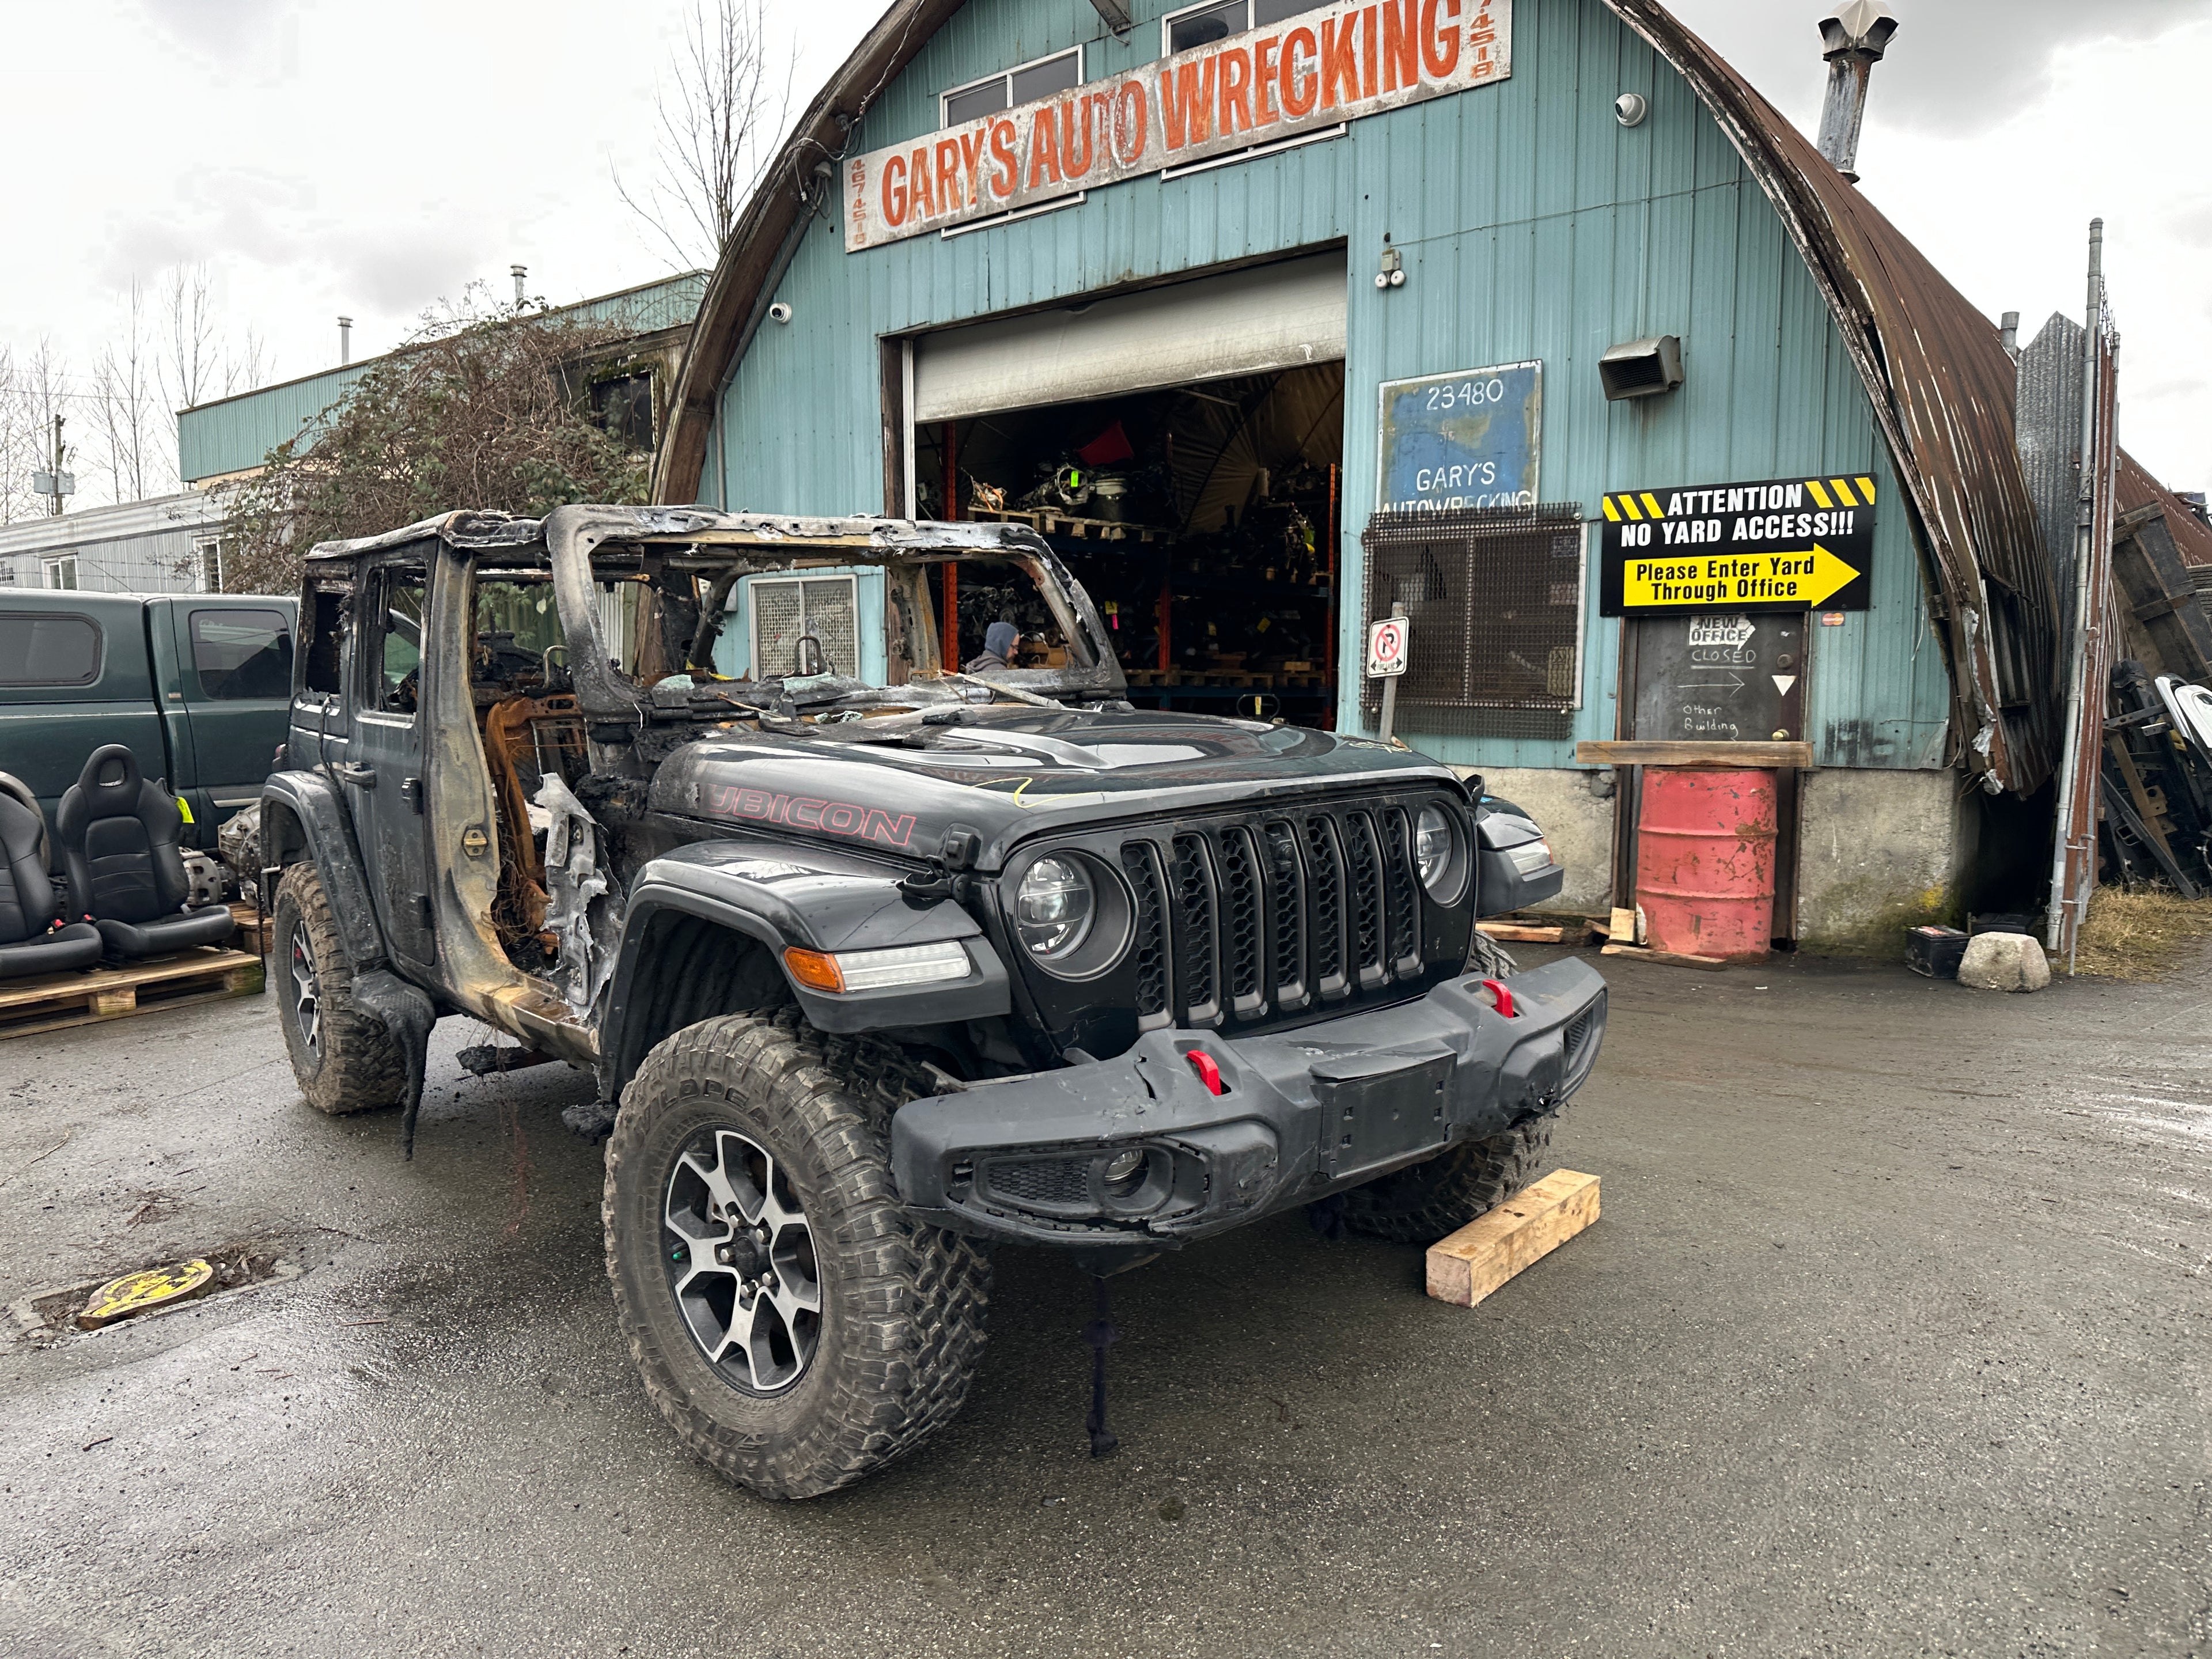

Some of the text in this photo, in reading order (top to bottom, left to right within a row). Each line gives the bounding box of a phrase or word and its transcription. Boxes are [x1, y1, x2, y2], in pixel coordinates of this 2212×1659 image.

[881, 0, 1461, 227] GARY'S AUTO WRECKING
[1426, 378, 1503, 411] 23480
[1416, 461, 1495, 491] GARY'S
[1667, 483, 1802, 516] ATTENTION
[1620, 511, 1854, 547] NO YARD ACCESS!!!
[1637, 555, 1815, 581] Please Enter Yard
[1651, 579, 1797, 602] Through Office
[1699, 616, 1738, 628] NEW
[1691, 629, 1748, 642] OFFICE
[1692, 649, 1756, 663] CLOSED
[1683, 704, 1722, 715] Other
[1684, 717, 1738, 738] Building
[707, 783, 916, 846] UBICON
